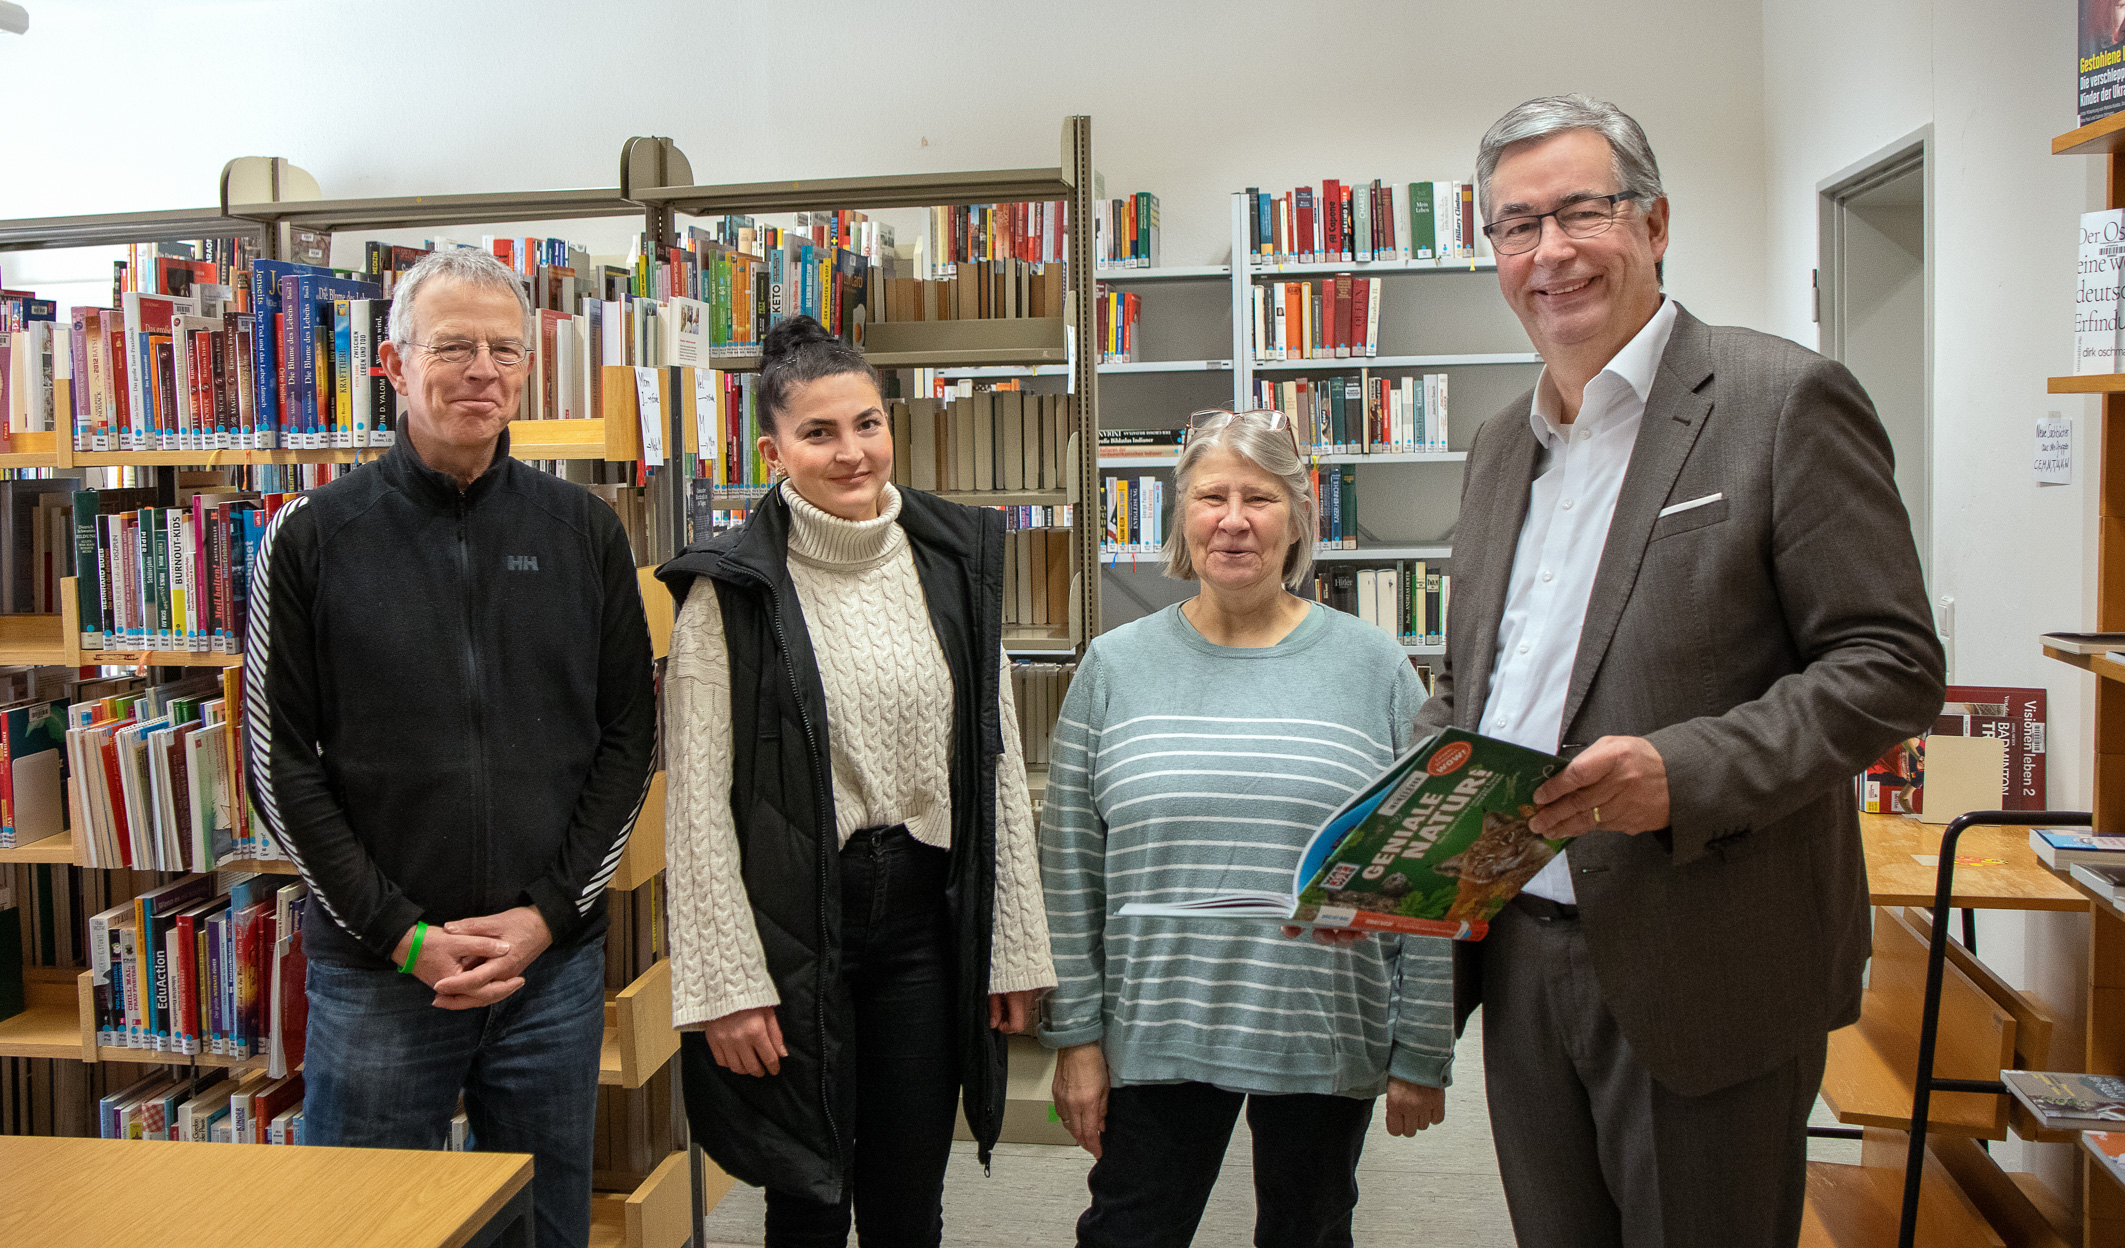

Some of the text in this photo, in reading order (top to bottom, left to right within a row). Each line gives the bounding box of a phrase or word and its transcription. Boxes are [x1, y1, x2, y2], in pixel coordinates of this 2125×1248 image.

[2080, 49, 2122, 73] Gestohlene
[2080, 67, 2125, 90] Die verschlepp
[2080, 87, 2112, 107] Kinder der
[1358, 188, 1366, 219] CHARLES
[1328, 201, 1337, 232] Capone
[2079, 221, 2125, 246] Der Os
[2077, 255, 2107, 275] eine
[256, 269, 265, 305] Jenseits
[318, 287, 328, 300] Die
[772, 285, 781, 313] KETO
[2075, 279, 2125, 303] deutsc
[2074, 309, 2125, 333] Erfindu
[303, 331, 311, 343] des
[2082, 347, 2125, 358] dirk oschma
[287, 372, 295, 385] Die
[339, 348, 347, 393] KRAFTTIERE
[173, 516, 183, 585] BURNOUT-KIDS
[507, 555, 539, 571] HH
[1334, 578, 1353, 587] Hitler
[2022, 700, 2037, 797] Visionen leben 2
[1401, 767, 1495, 860] NATUR!
[1361, 792, 1444, 880] GENIALE
[156, 950, 168, 1009] EduAction
